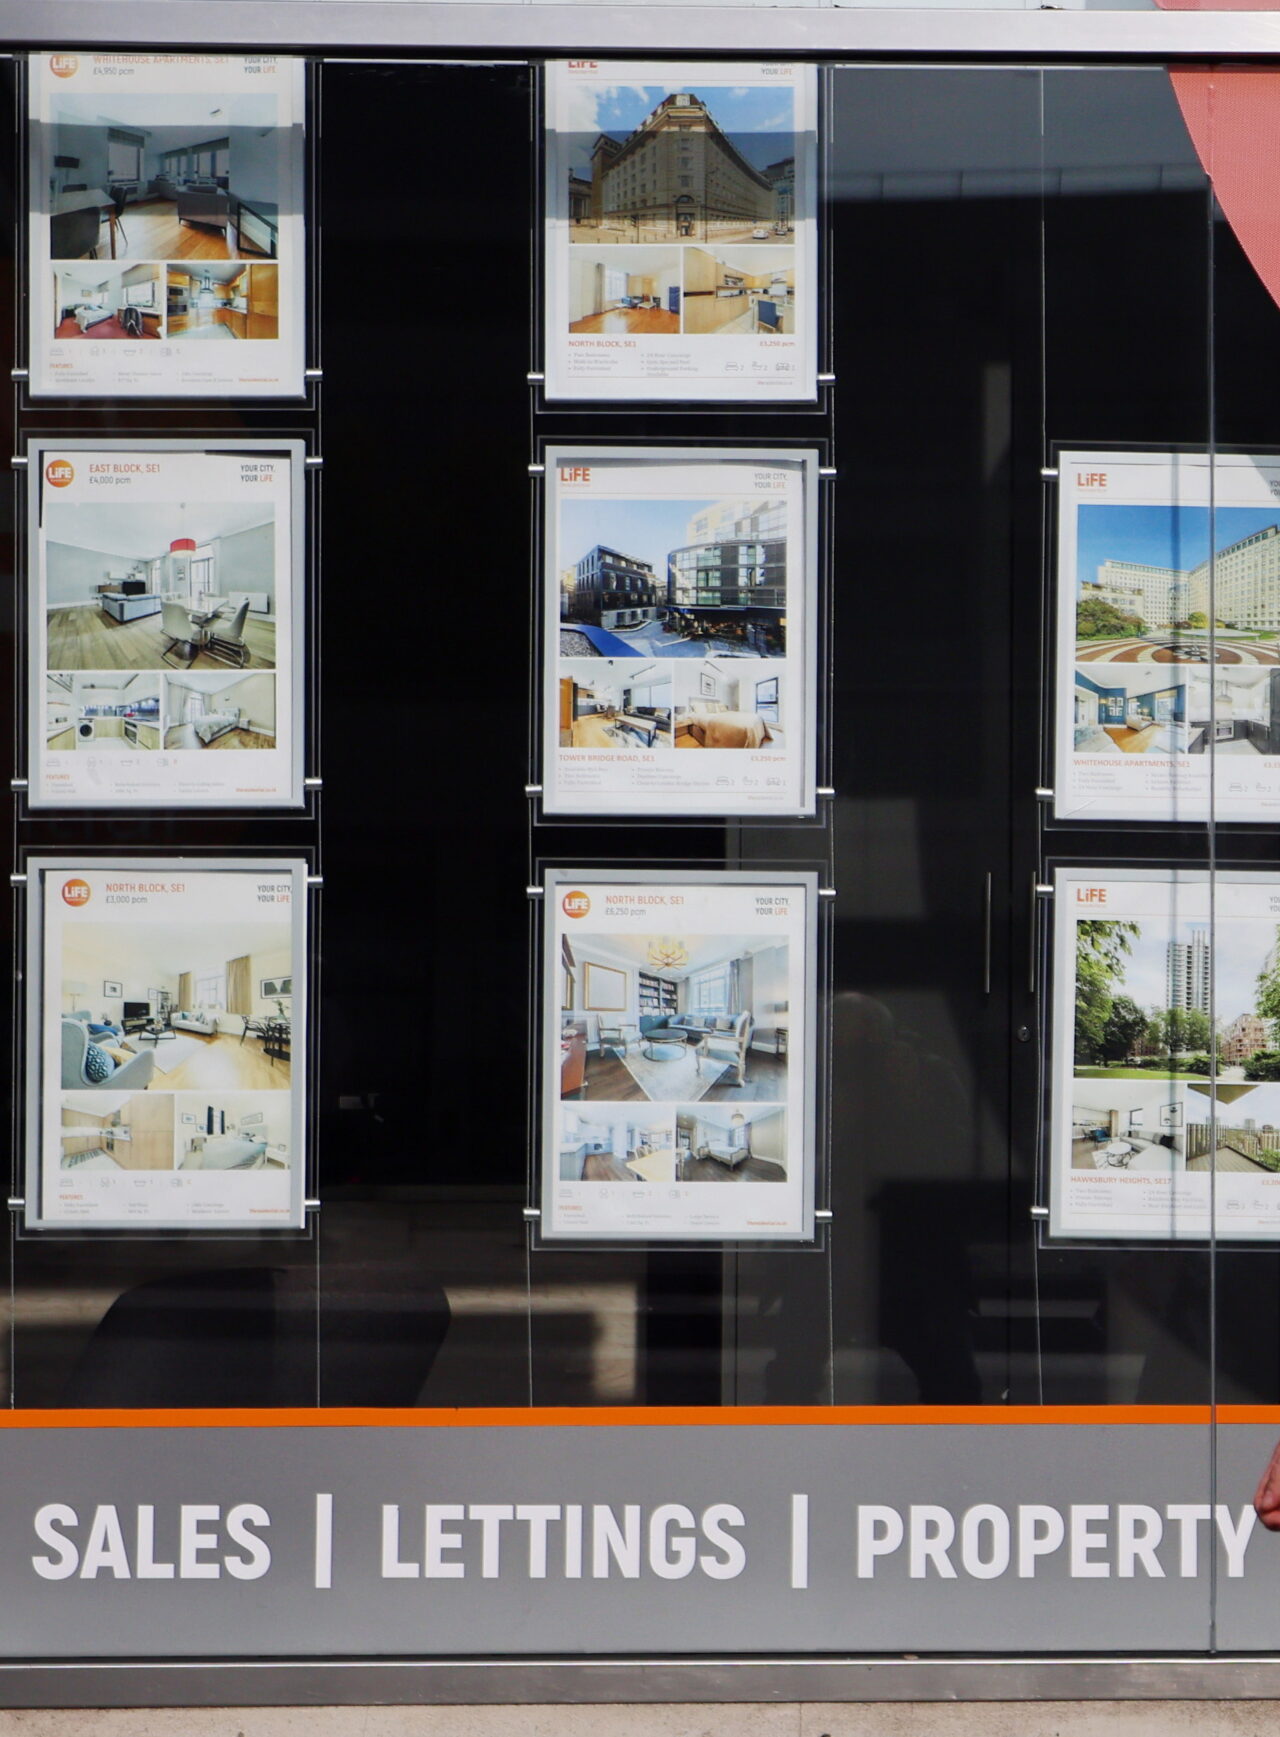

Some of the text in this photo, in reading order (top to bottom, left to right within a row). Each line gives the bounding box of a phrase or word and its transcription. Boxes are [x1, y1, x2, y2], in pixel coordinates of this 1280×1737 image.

[244, 66, 260, 74] YOUR
[568, 340, 595, 348] NORTH
[89, 464, 110, 472] EAST
[146, 464, 160, 473] SE1
[240, 464, 258, 472] YOUR
[240, 474, 258, 482] YOUR
[560, 754, 586, 762] TOWER
[588, 754, 615, 762] BRIDGE
[106, 884, 136, 892] NORTH
[170, 884, 185, 892] SE1
[132, 896, 148, 904] pcm
[258, 894, 275, 902] YOUR
[606, 896, 635, 904] NORTH
[670, 896, 684, 904] SE1
[630, 908, 646, 916] pcm
[31, 1503, 271, 1580] SALES
[381, 1503, 747, 1580] LETTINGS
[857, 1503, 1258, 1580] PROPERTY
